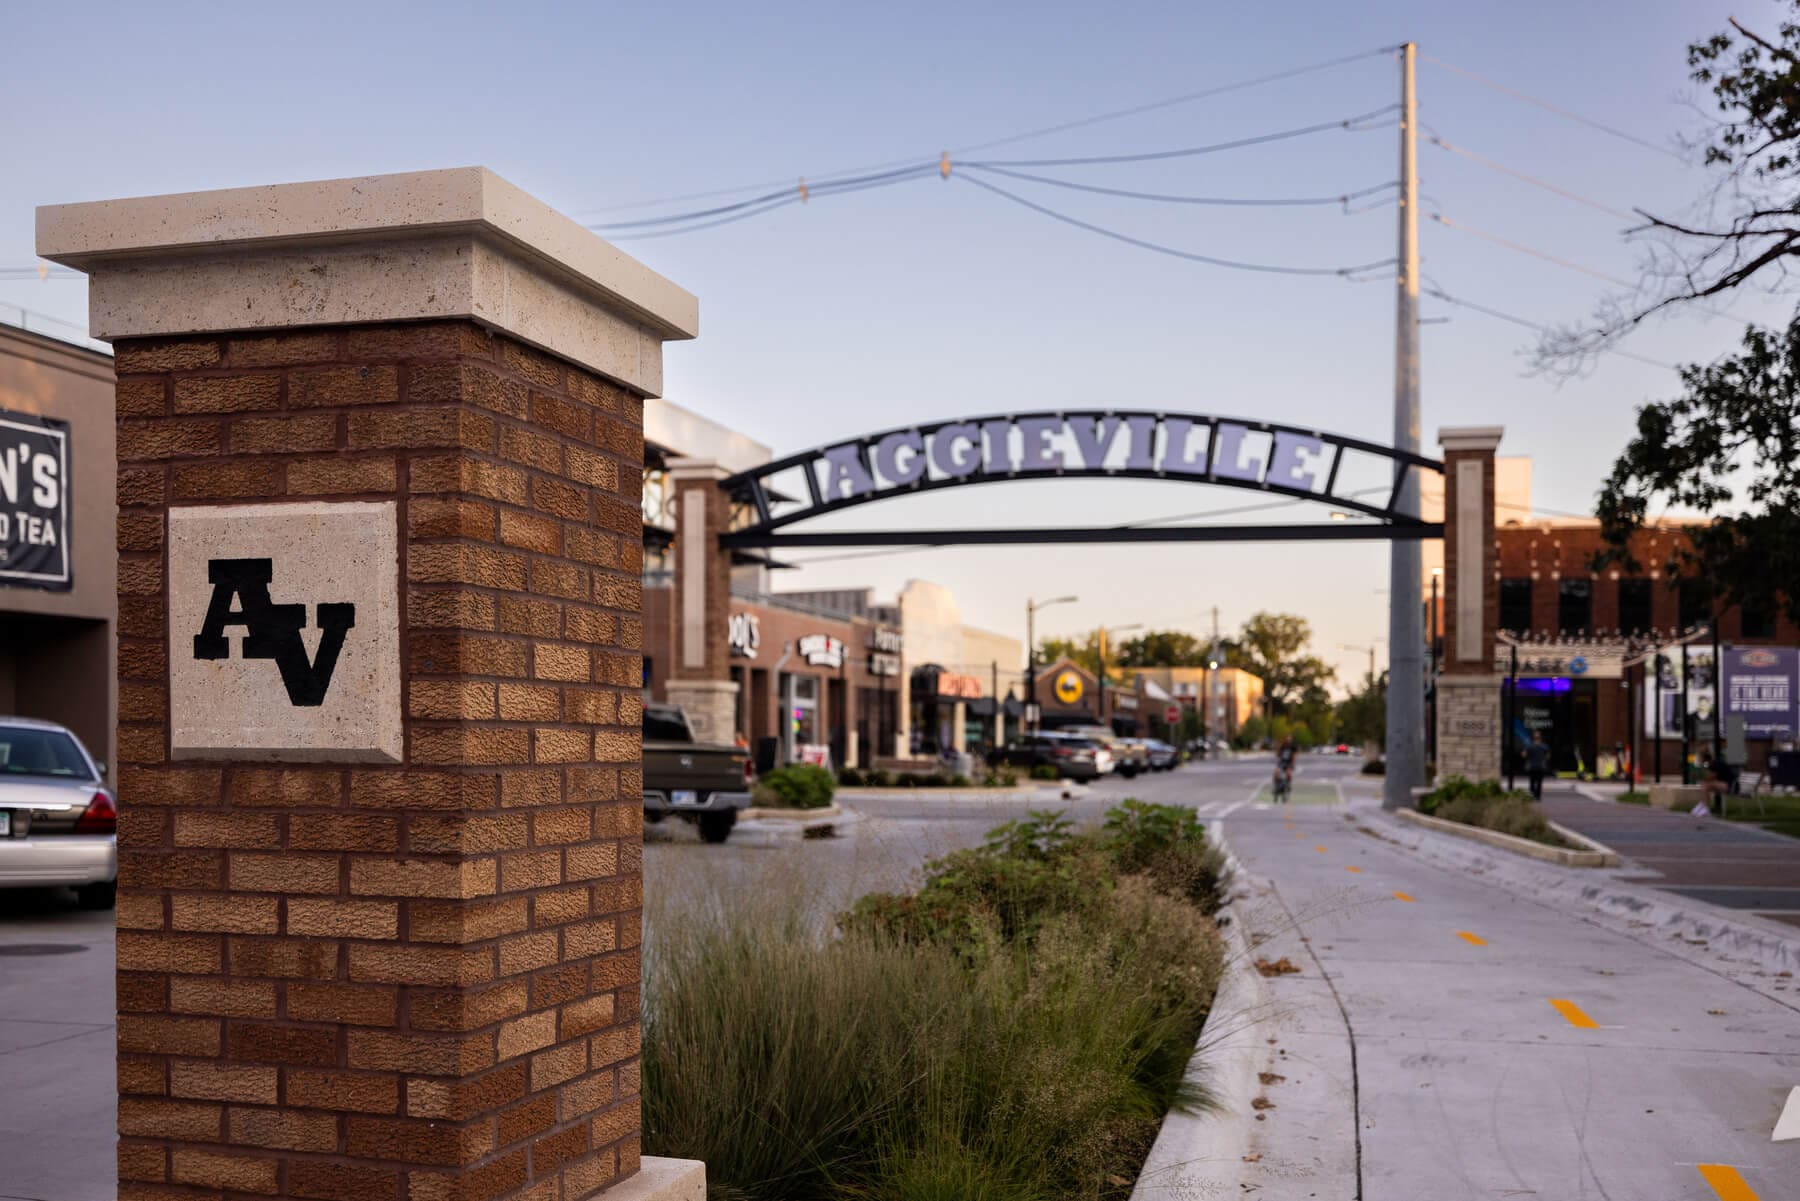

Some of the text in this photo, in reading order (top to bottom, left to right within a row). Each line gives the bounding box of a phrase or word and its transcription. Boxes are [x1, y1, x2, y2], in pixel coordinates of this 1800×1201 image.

[827, 414, 1322, 500] AGGIEVILLE
[16, 511, 57, 547] TEA
[193, 557, 355, 707] AV
